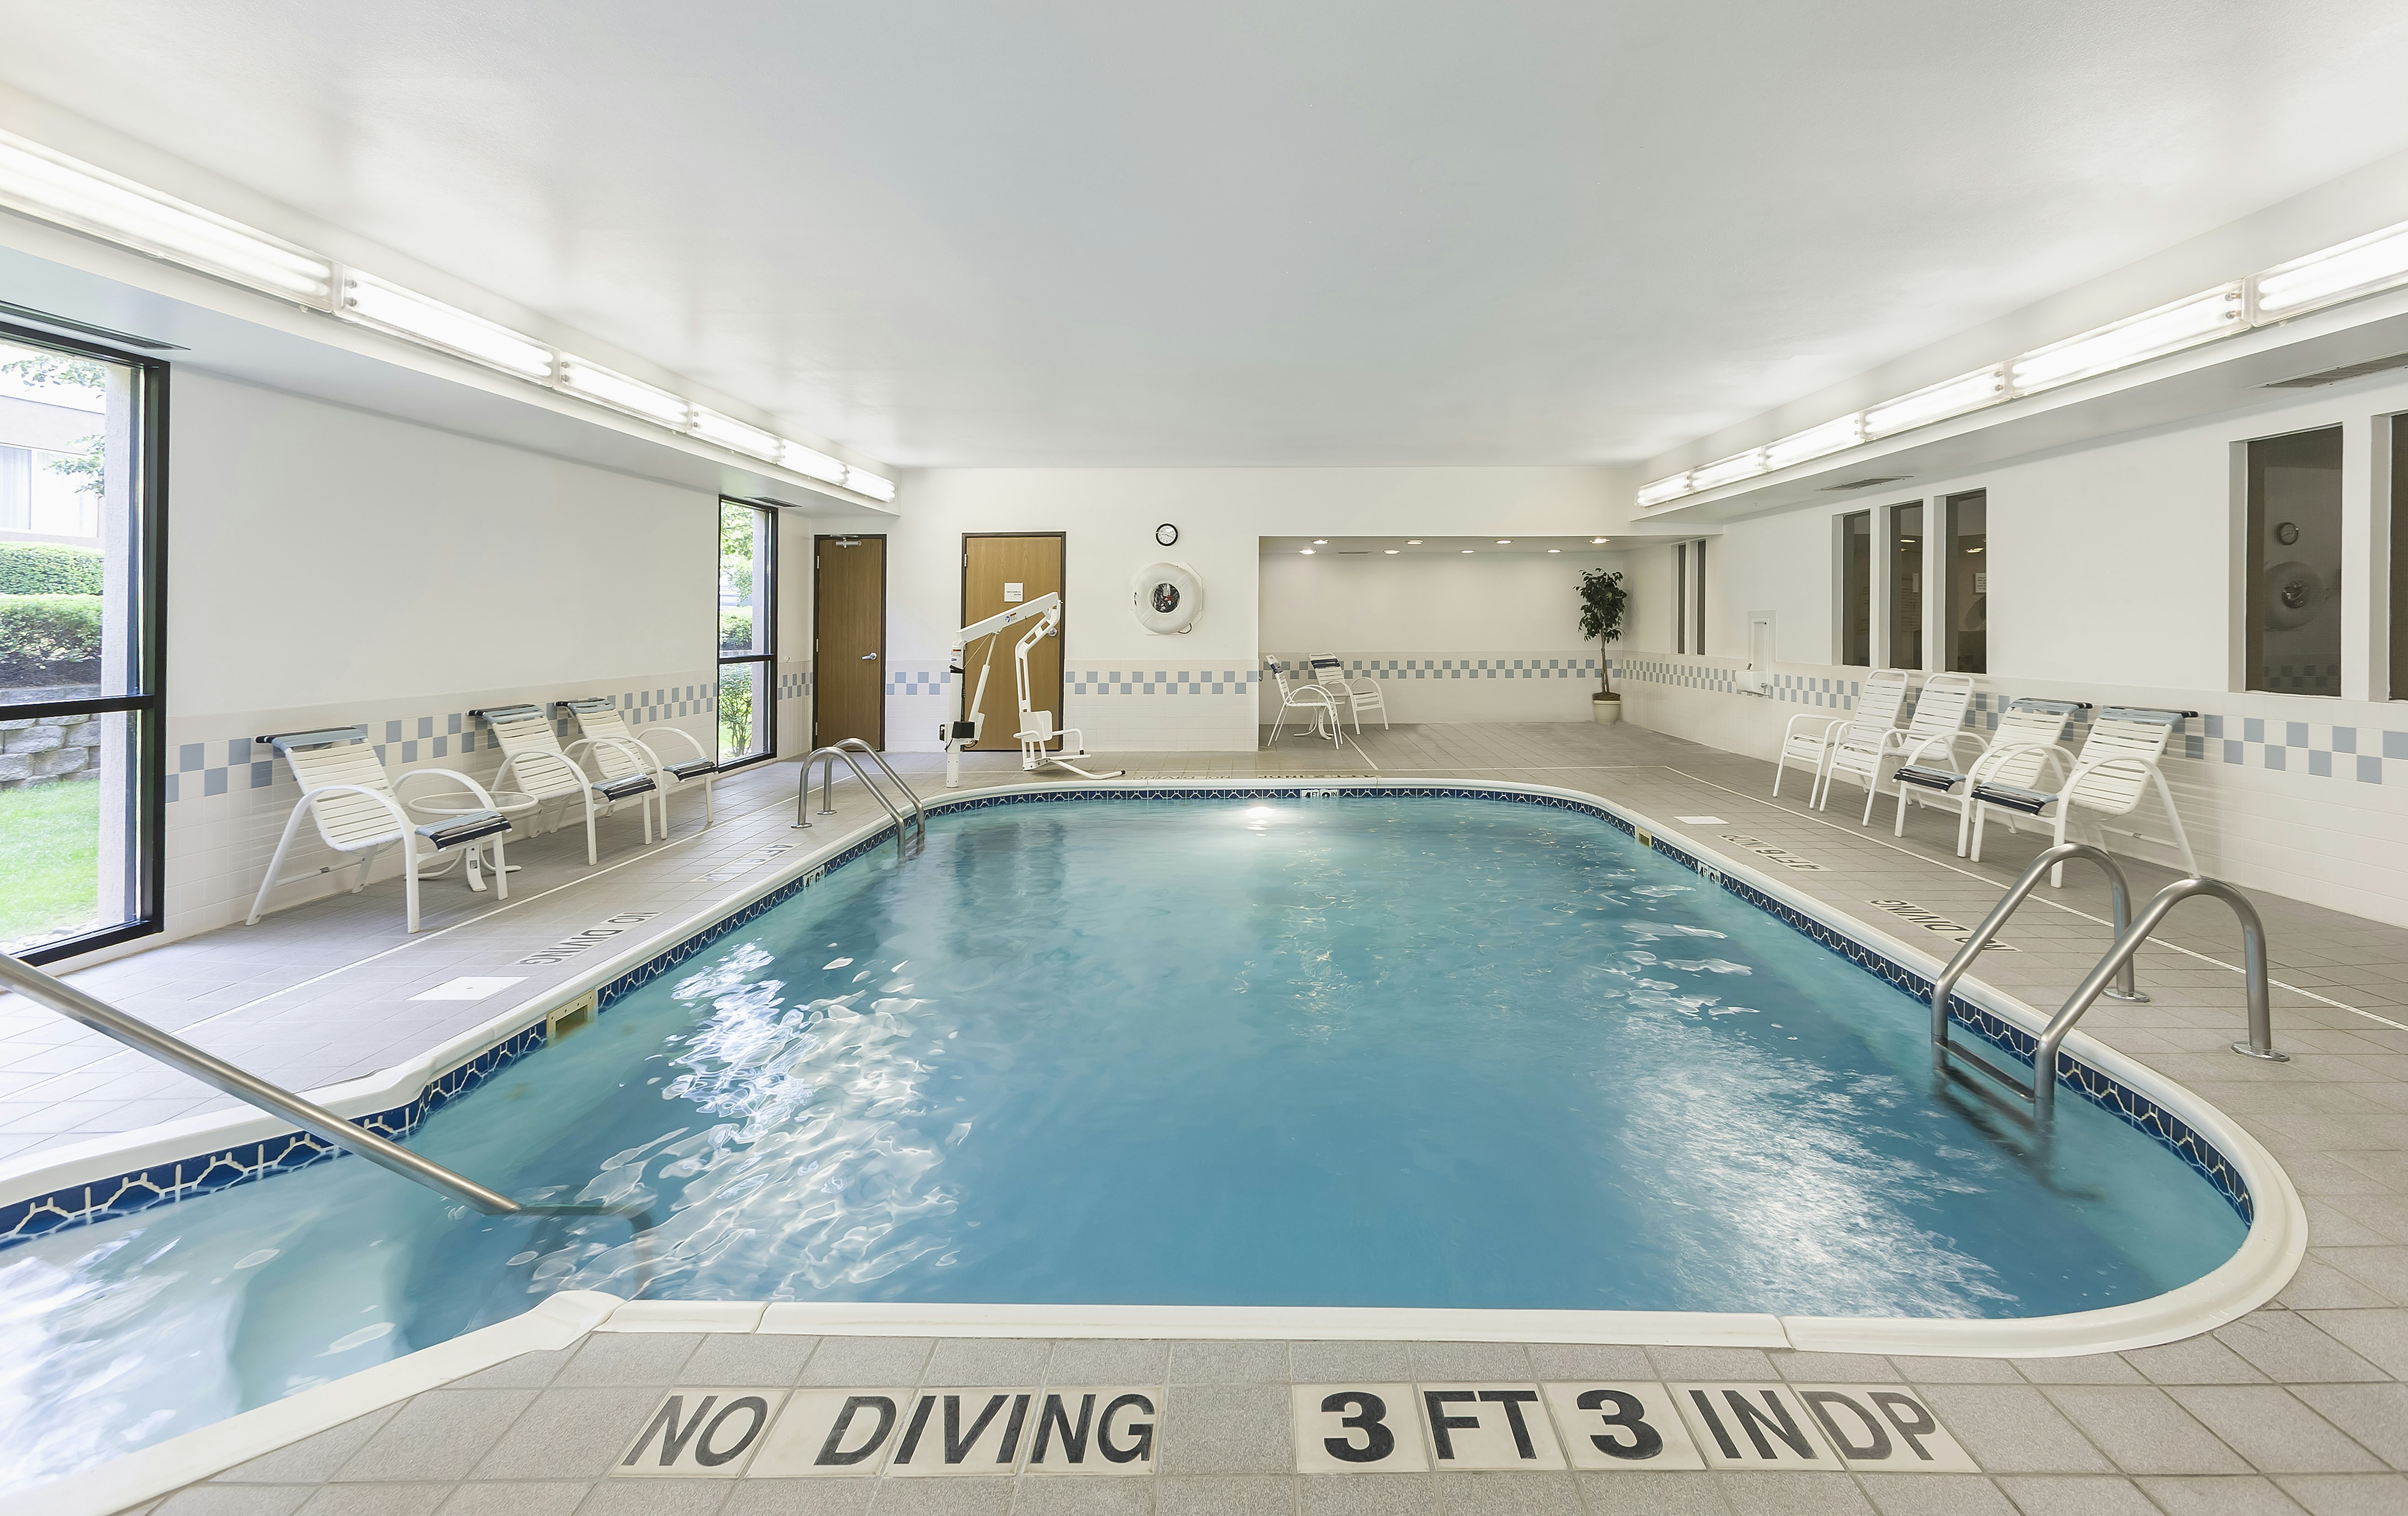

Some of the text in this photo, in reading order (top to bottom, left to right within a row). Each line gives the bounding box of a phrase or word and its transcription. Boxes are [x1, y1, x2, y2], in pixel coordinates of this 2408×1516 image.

[515, 912, 659, 965] NO DIVING
[1870, 900, 1970, 931] DIVING
[622, 1393, 1155, 1468] NO DIVING
[1319, 1391, 1395, 1463] 3
[1425, 1390, 1539, 1461] FT
[1576, 1389, 1663, 1461] 3
